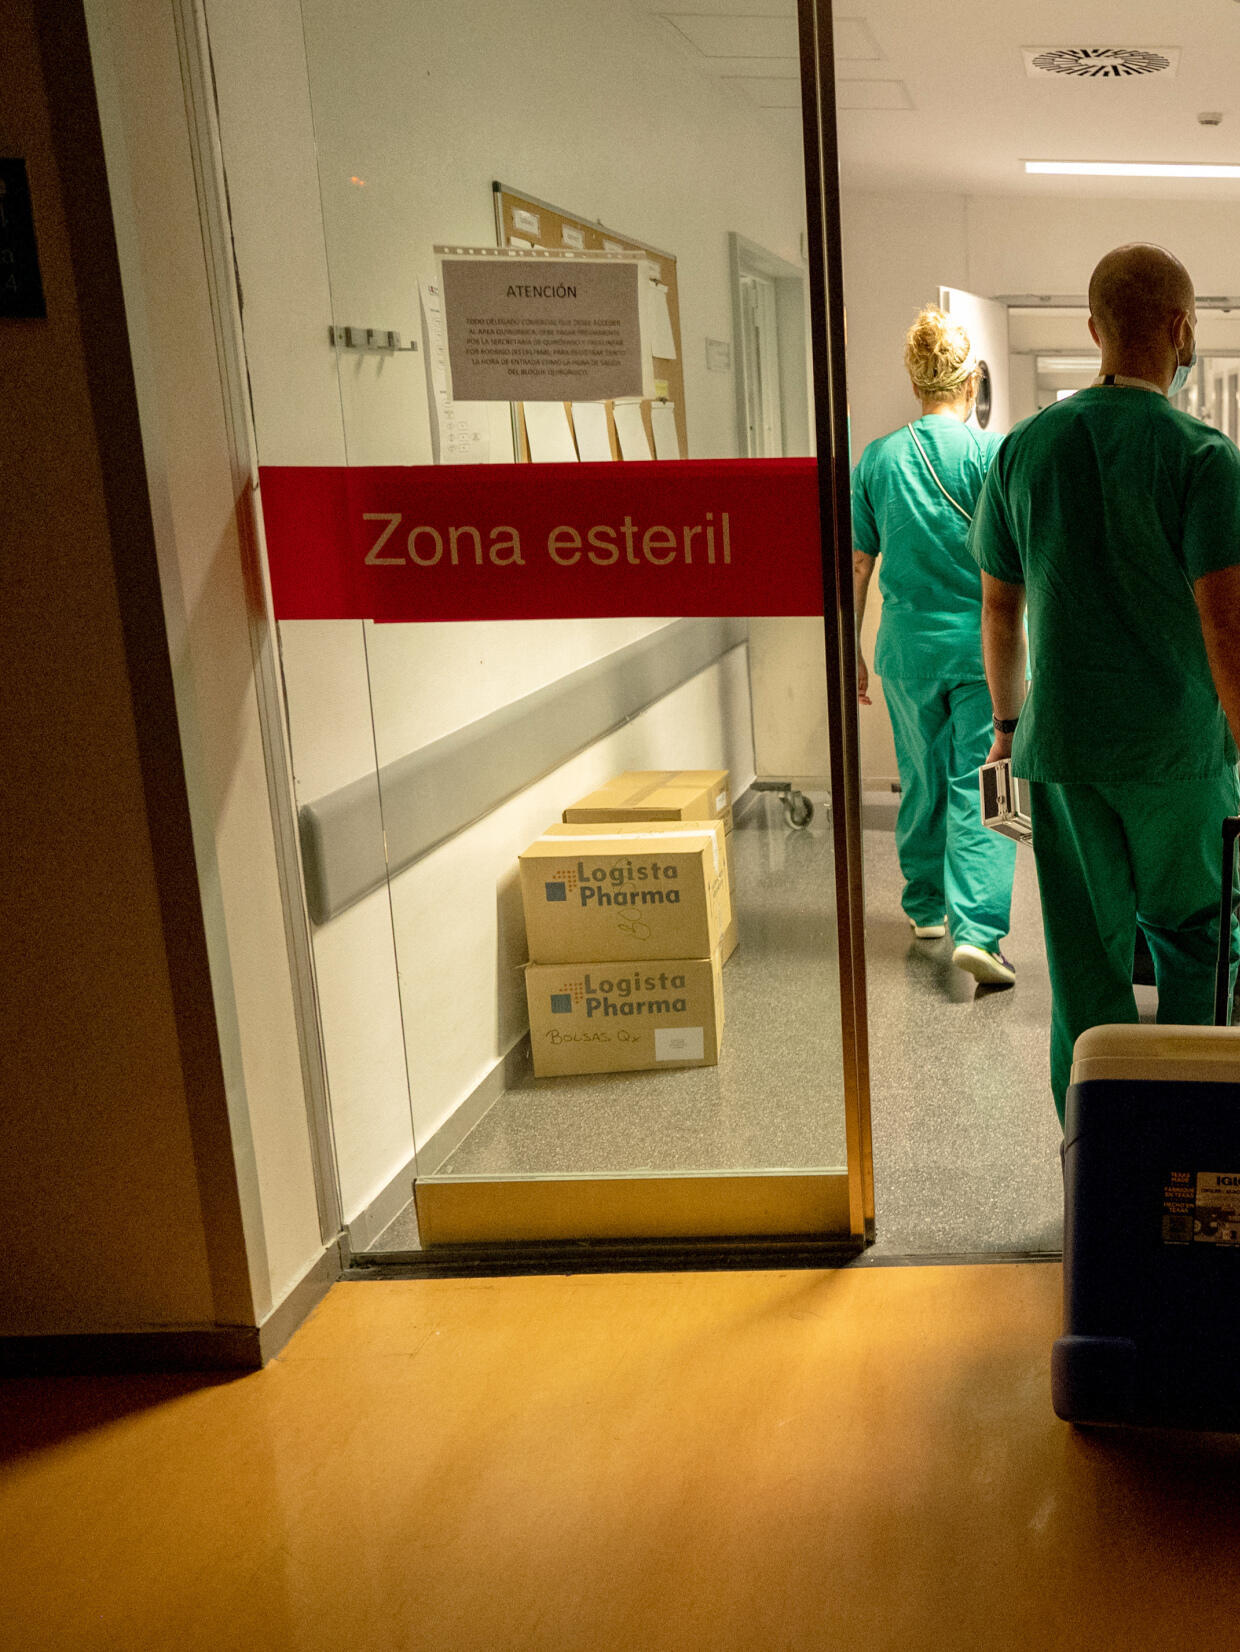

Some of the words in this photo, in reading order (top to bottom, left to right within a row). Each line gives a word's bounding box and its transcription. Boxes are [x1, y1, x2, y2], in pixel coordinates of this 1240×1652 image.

[506, 283, 577, 298] ATENCIÓN
[362, 513, 526, 566] Zona
[547, 512, 732, 566] esteril
[578, 861, 679, 886] Logista
[580, 885, 681, 907] Pharma
[584, 972, 686, 997] Logista
[586, 996, 687, 1018] Pharma
